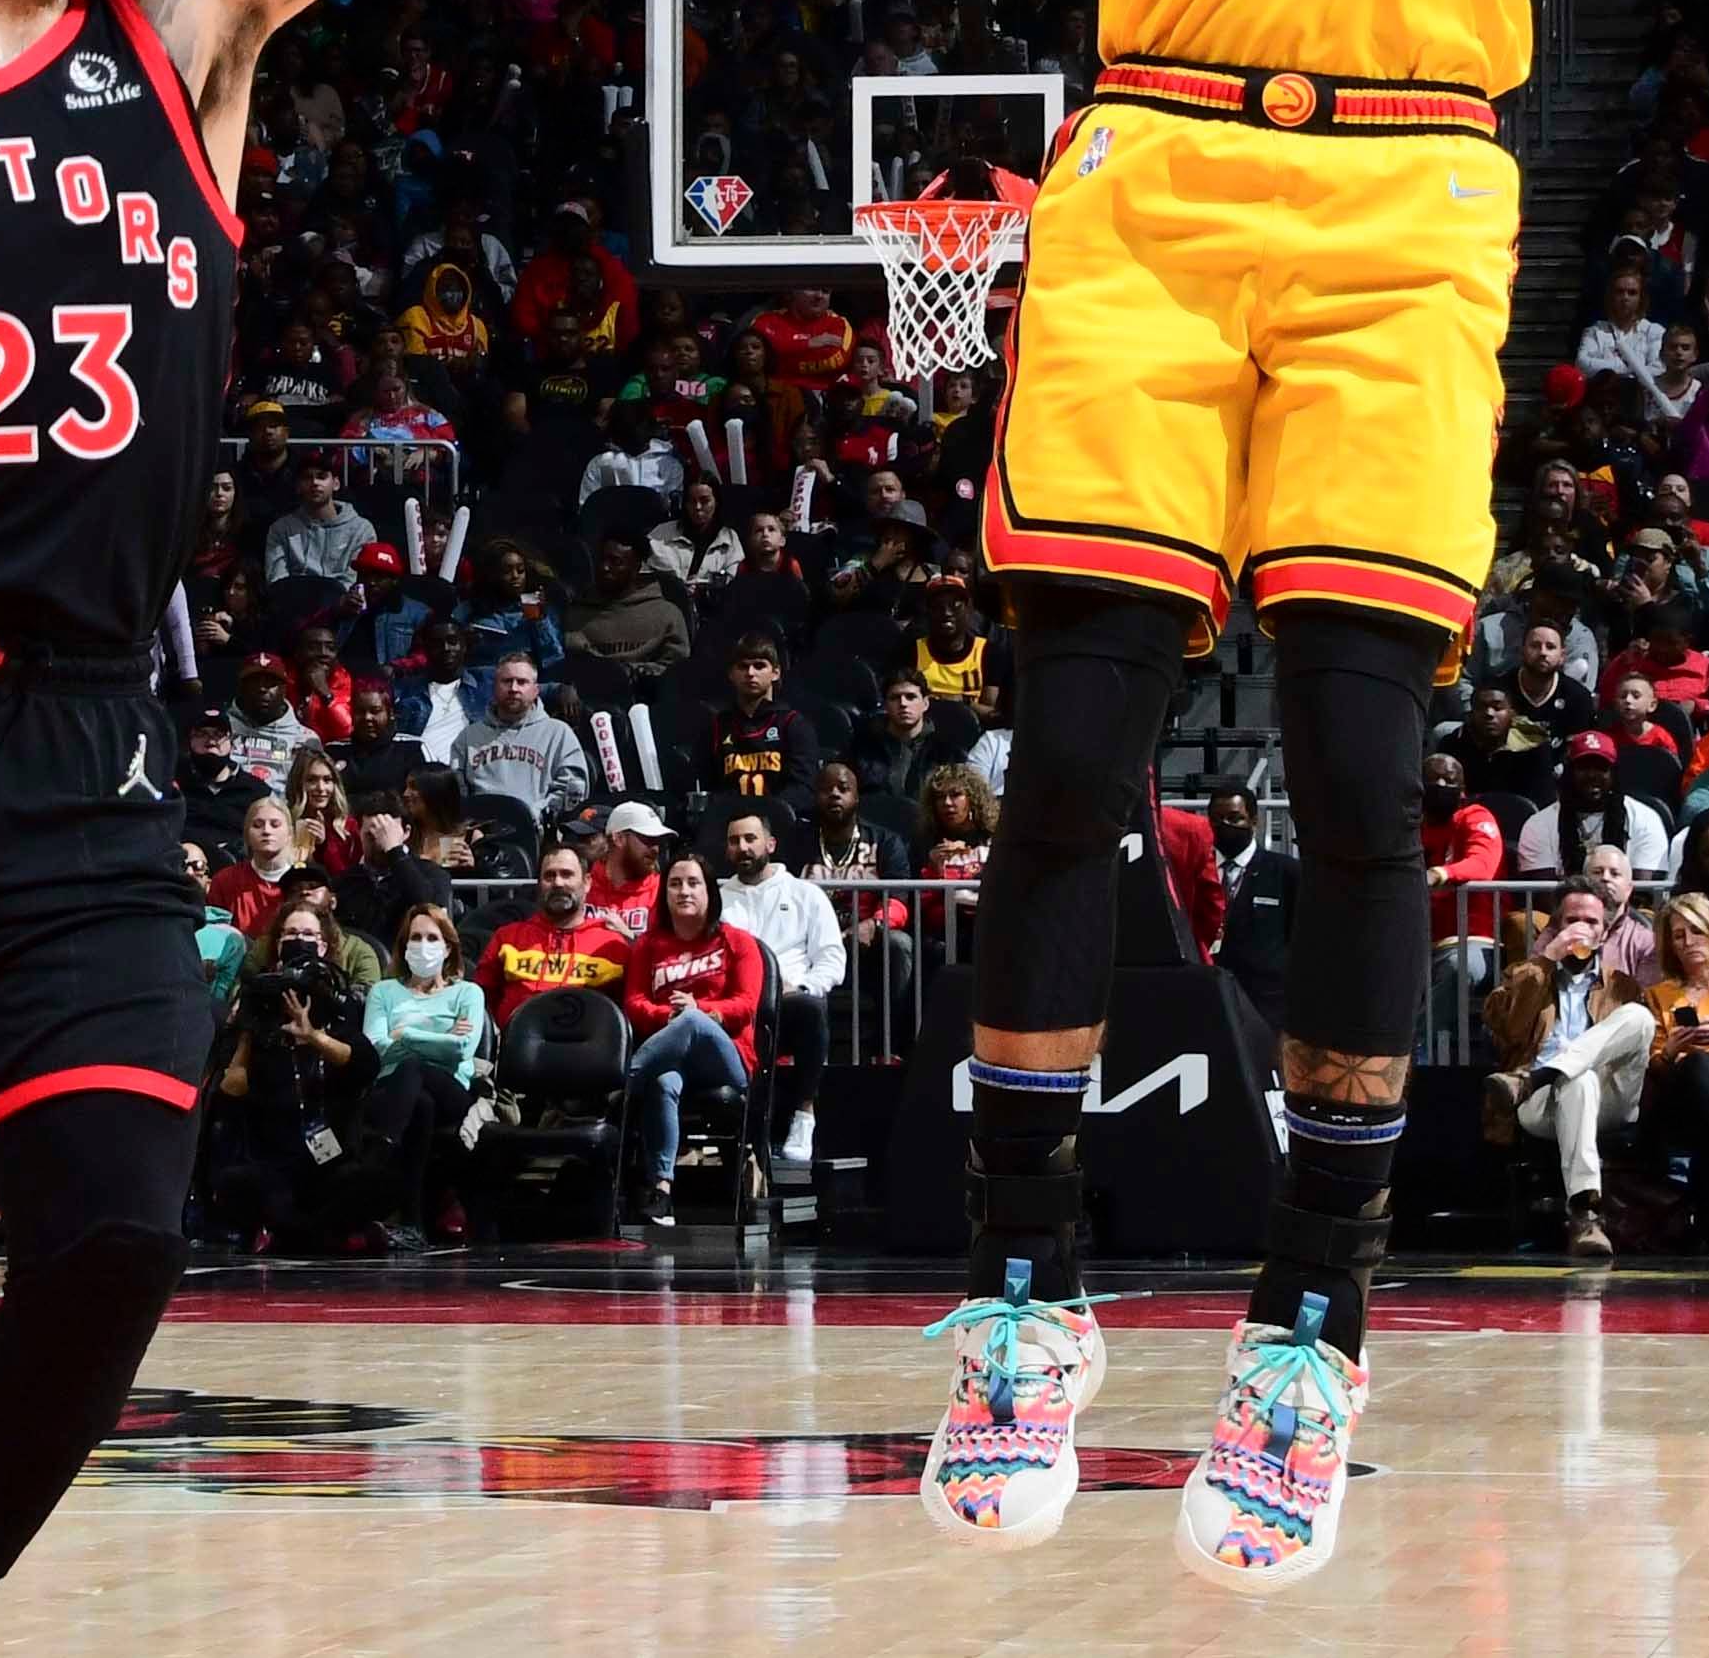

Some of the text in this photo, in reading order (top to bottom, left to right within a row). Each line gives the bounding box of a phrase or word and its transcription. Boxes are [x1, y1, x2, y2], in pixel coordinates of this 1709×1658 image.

[64, 80, 143, 111] Sun Life
[471, 744, 548, 773] SYRACUSE
[723, 750, 782, 774] HAWKS
[738, 774, 766, 797] 11
[517, 953, 600, 979] HAWKS
